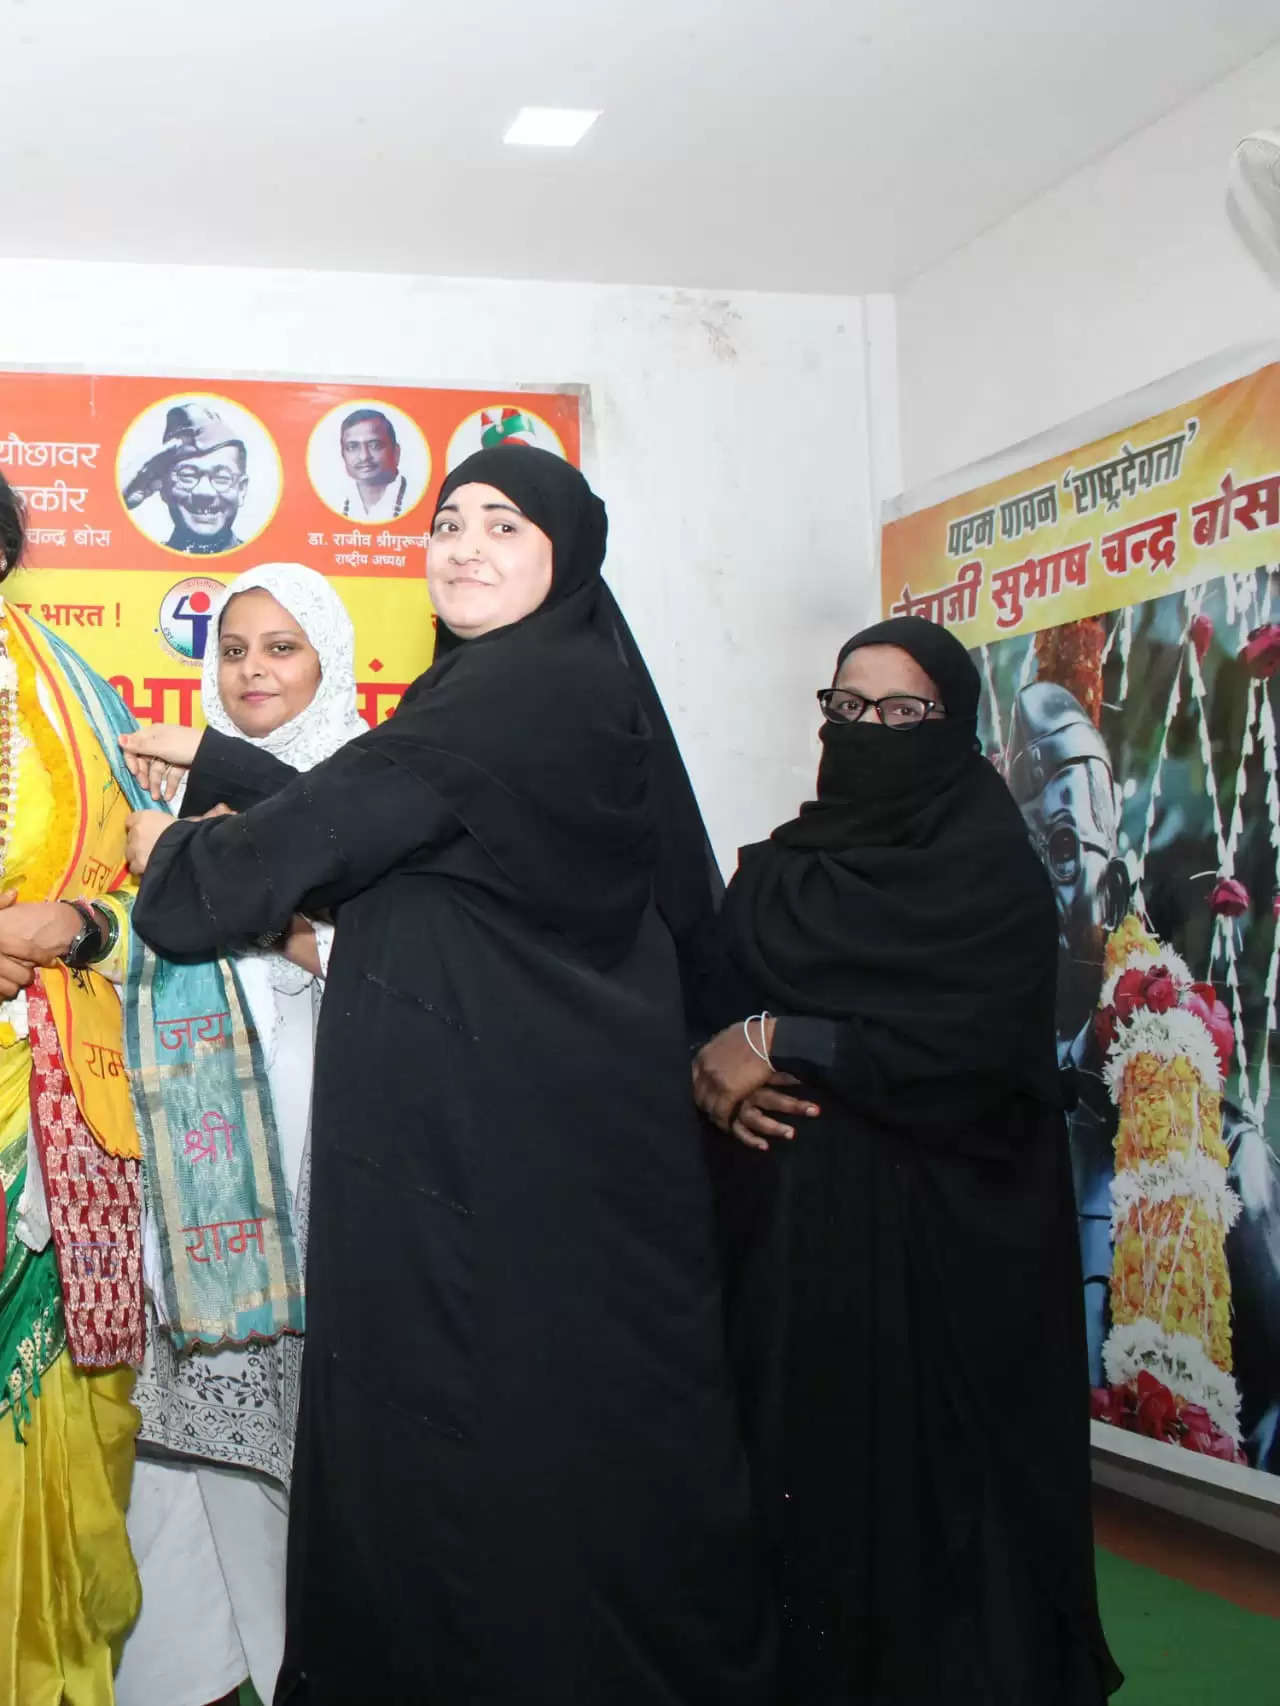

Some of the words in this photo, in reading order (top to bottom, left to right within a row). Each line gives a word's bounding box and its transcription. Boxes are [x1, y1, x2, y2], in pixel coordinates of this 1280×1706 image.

[73, 524, 112, 546] बोस
[307, 532, 328, 546] डा.
[333, 529, 372, 547] राजीव
[948, 508, 995, 556] परम
[1000, 484, 1058, 538] पावन
[372, 554, 406, 567] अध्यक्ष
[991, 543, 1091, 628] सुभाष
[1102, 513, 1177, 573] चन्द्र
[42, 604, 104, 627] भारत
[155, 1013, 229, 1050] जय
[184, 1111, 238, 1163] श्री
[182, 1218, 270, 1263] राम
